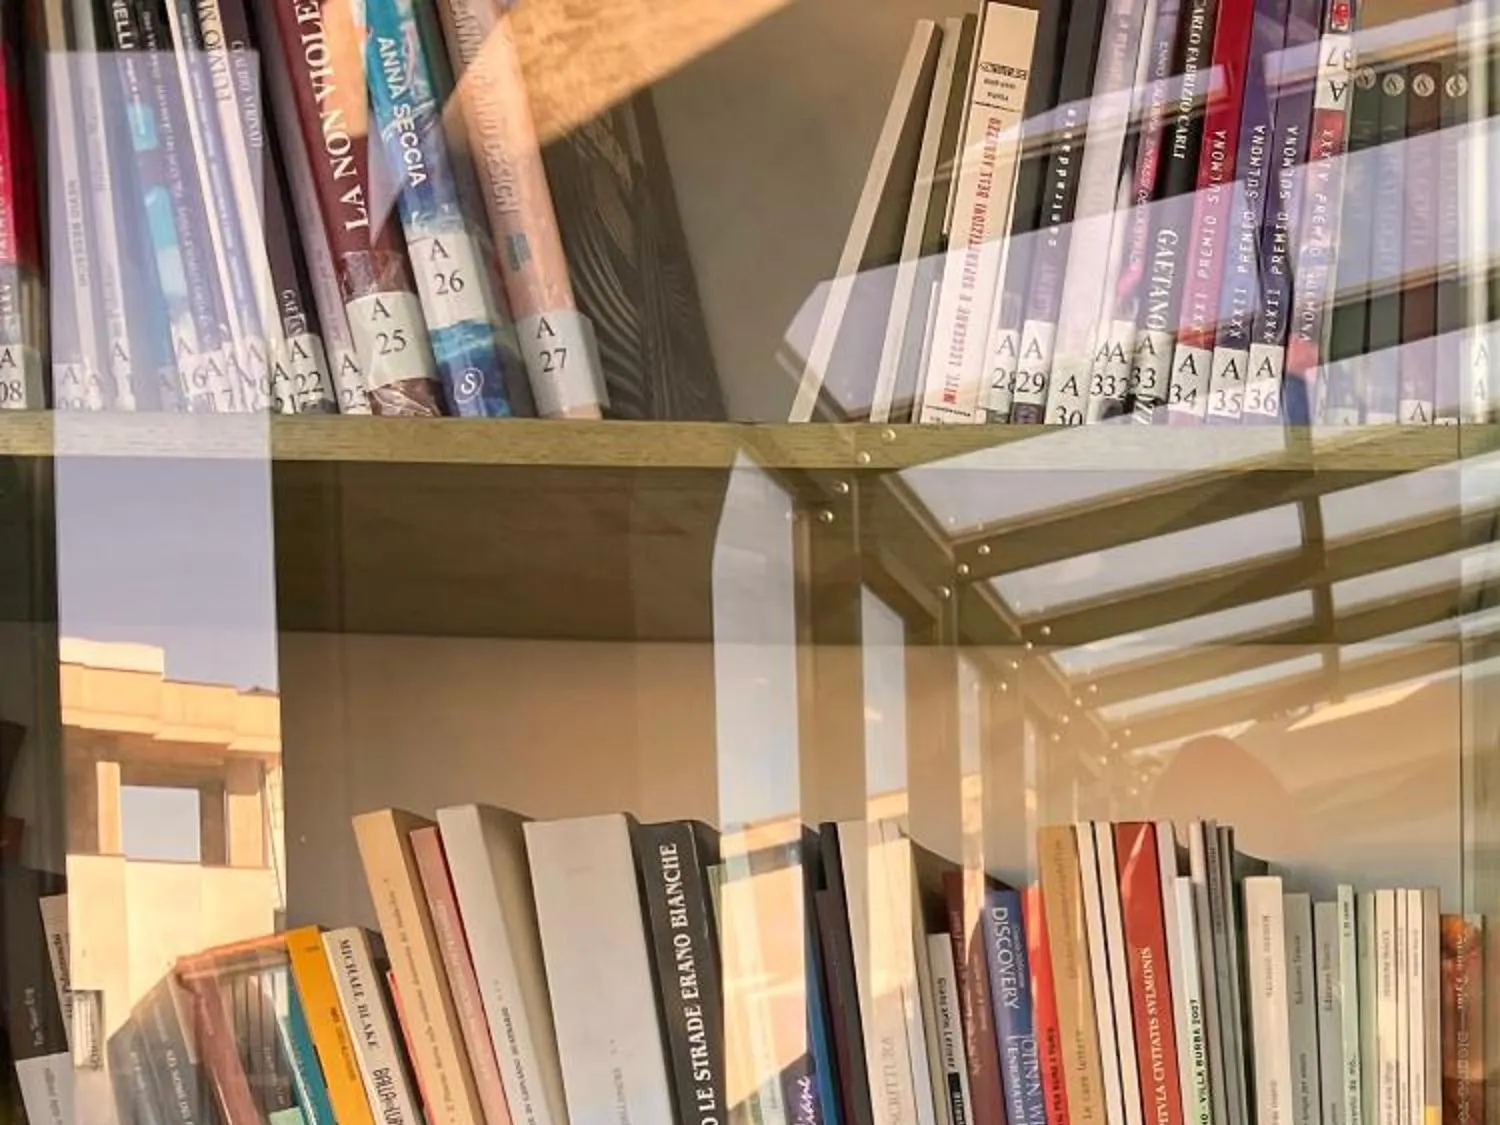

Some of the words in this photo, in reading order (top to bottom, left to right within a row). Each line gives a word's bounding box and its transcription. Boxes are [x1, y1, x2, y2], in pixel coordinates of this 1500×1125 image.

[295, 0, 338, 104] VIOLE
[320, 108, 358, 180] NON
[377, 36, 405, 100] ANNA
[393, 103, 427, 187] SECCIA
[1207, 130, 1228, 204] SULMONA
[1248, 124, 1267, 199] SULMONA
[1280, 124, 1300, 200] SULMONA
[339, 184, 370, 231] LA
[1271, 211, 1290, 276] PREMIO
[435, 272, 464, 294] 26
[1148, 229, 1179, 332] GAETANO
[1198, 215, 1218, 279] PREMIO
[378, 333, 406, 353] 25
[1018, 371, 1045, 393] 29
[659, 842, 688, 930] BIANCHE
[673, 933, 700, 999] ERANO
[991, 906, 1020, 1010] DISCOVERY
[682, 1006, 711, 1083] STRADE
[698, 1086, 717, 1112] LE
